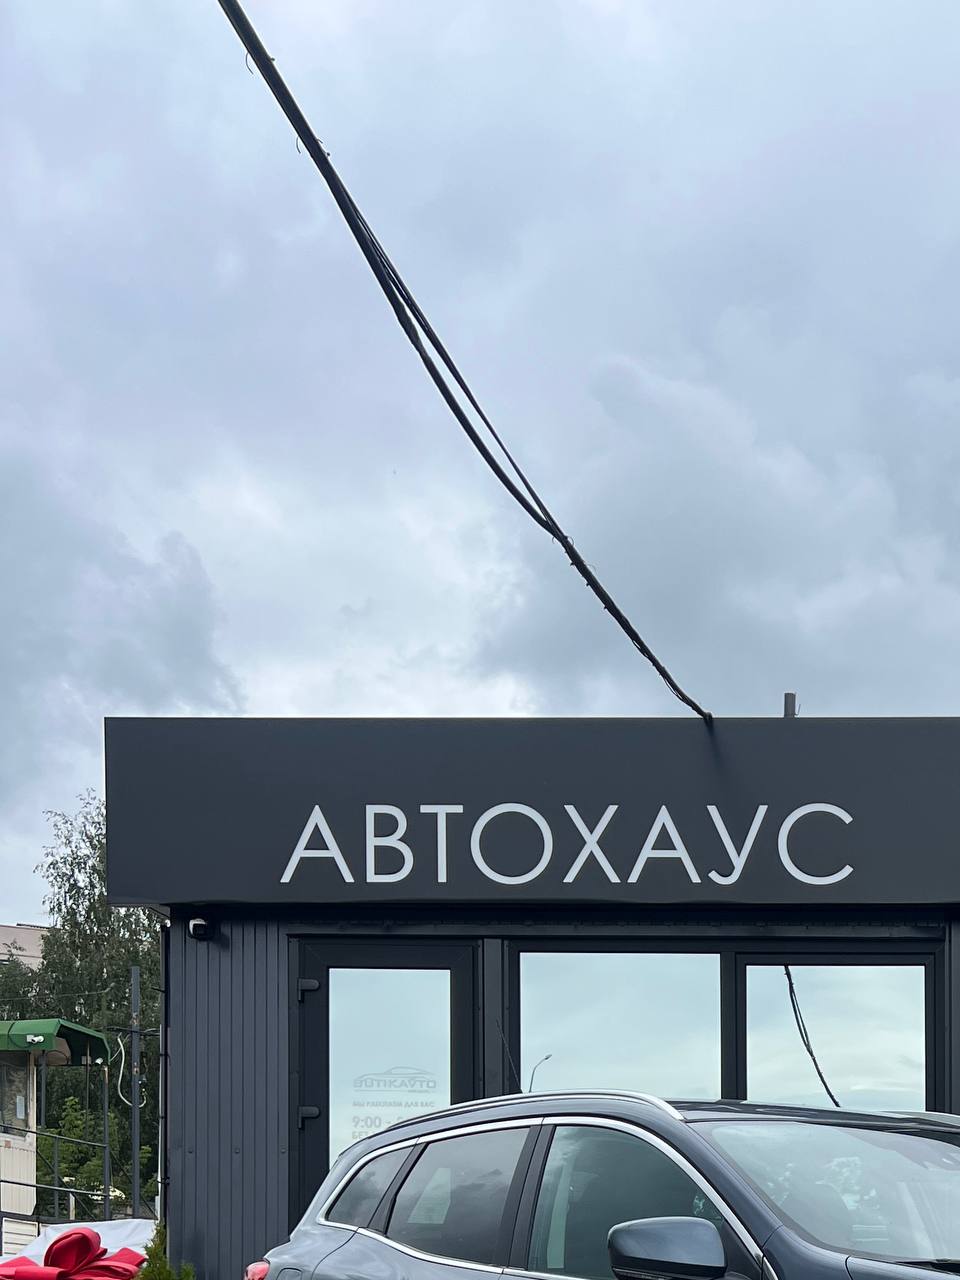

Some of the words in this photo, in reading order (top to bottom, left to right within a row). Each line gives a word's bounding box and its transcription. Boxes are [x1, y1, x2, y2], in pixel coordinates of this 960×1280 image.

[280, 803, 854, 885] АВТОХАУС
[353, 1079, 437, 1089] BUTIKAVTO
[352, 1116, 382, 1128] 9:00
